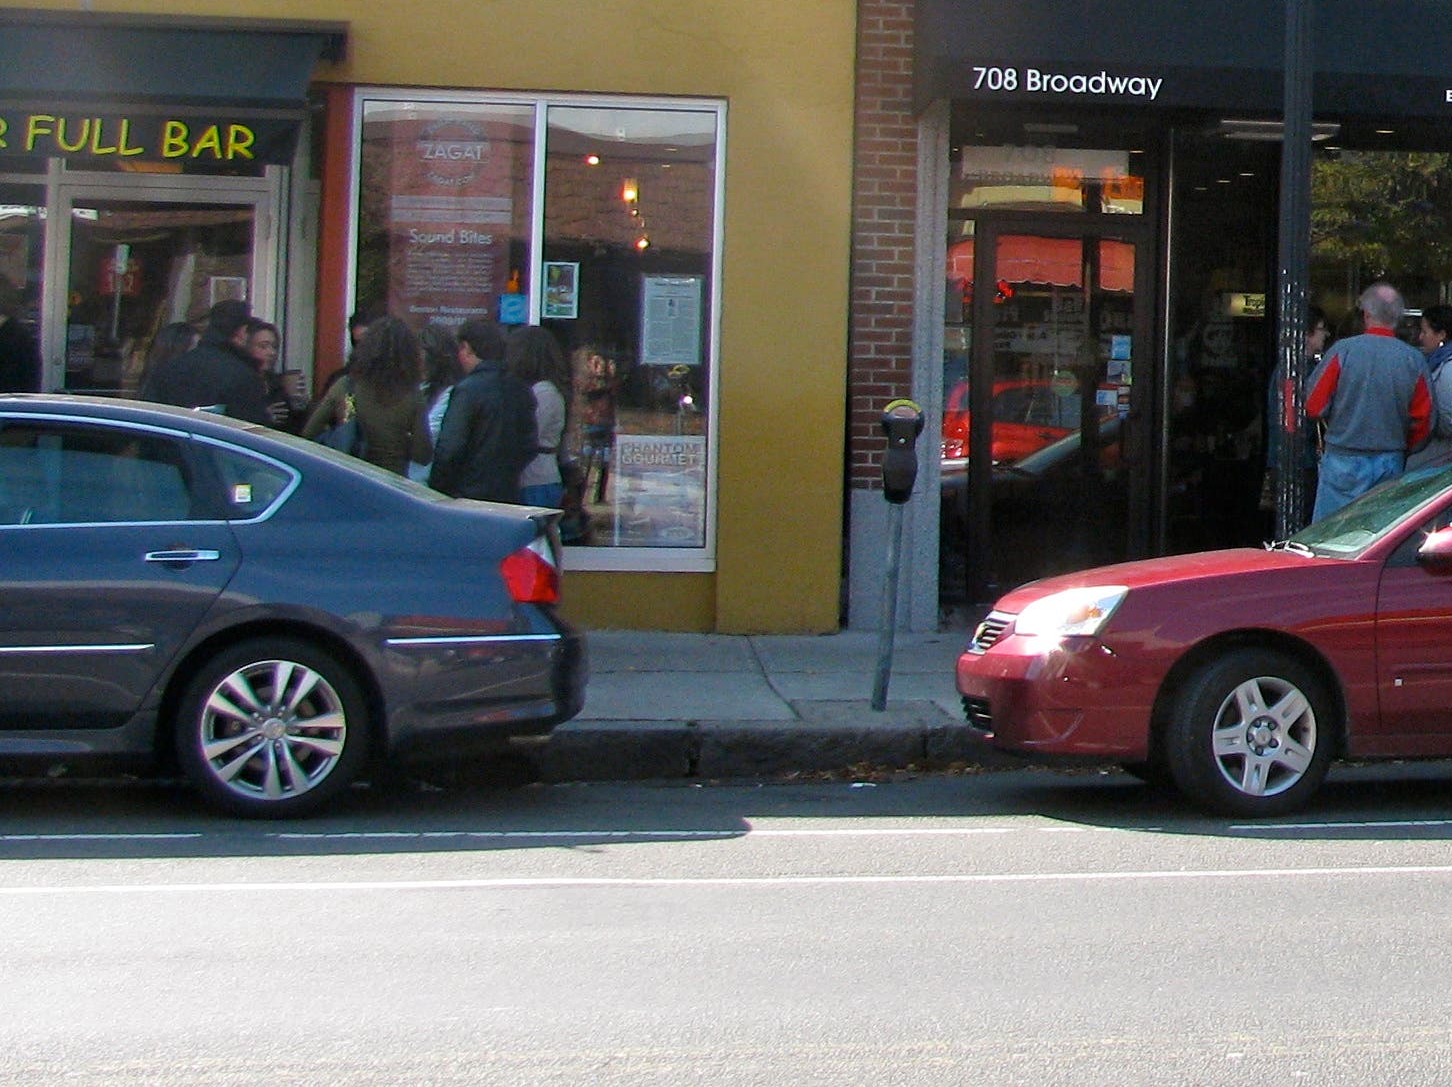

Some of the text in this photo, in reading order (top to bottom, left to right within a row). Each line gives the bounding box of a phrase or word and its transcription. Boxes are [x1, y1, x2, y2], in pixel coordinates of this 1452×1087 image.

[972, 67, 1163, 100] 708 Broadway
[26, 115, 144, 156] FULL
[162, 120, 255, 160] BAR
[423, 143, 483, 162] ZAGAT
[408, 228, 494, 245] Sound Bites
[621, 442, 698, 453] PHANTOM
[621, 453, 697, 466] GOURMET
